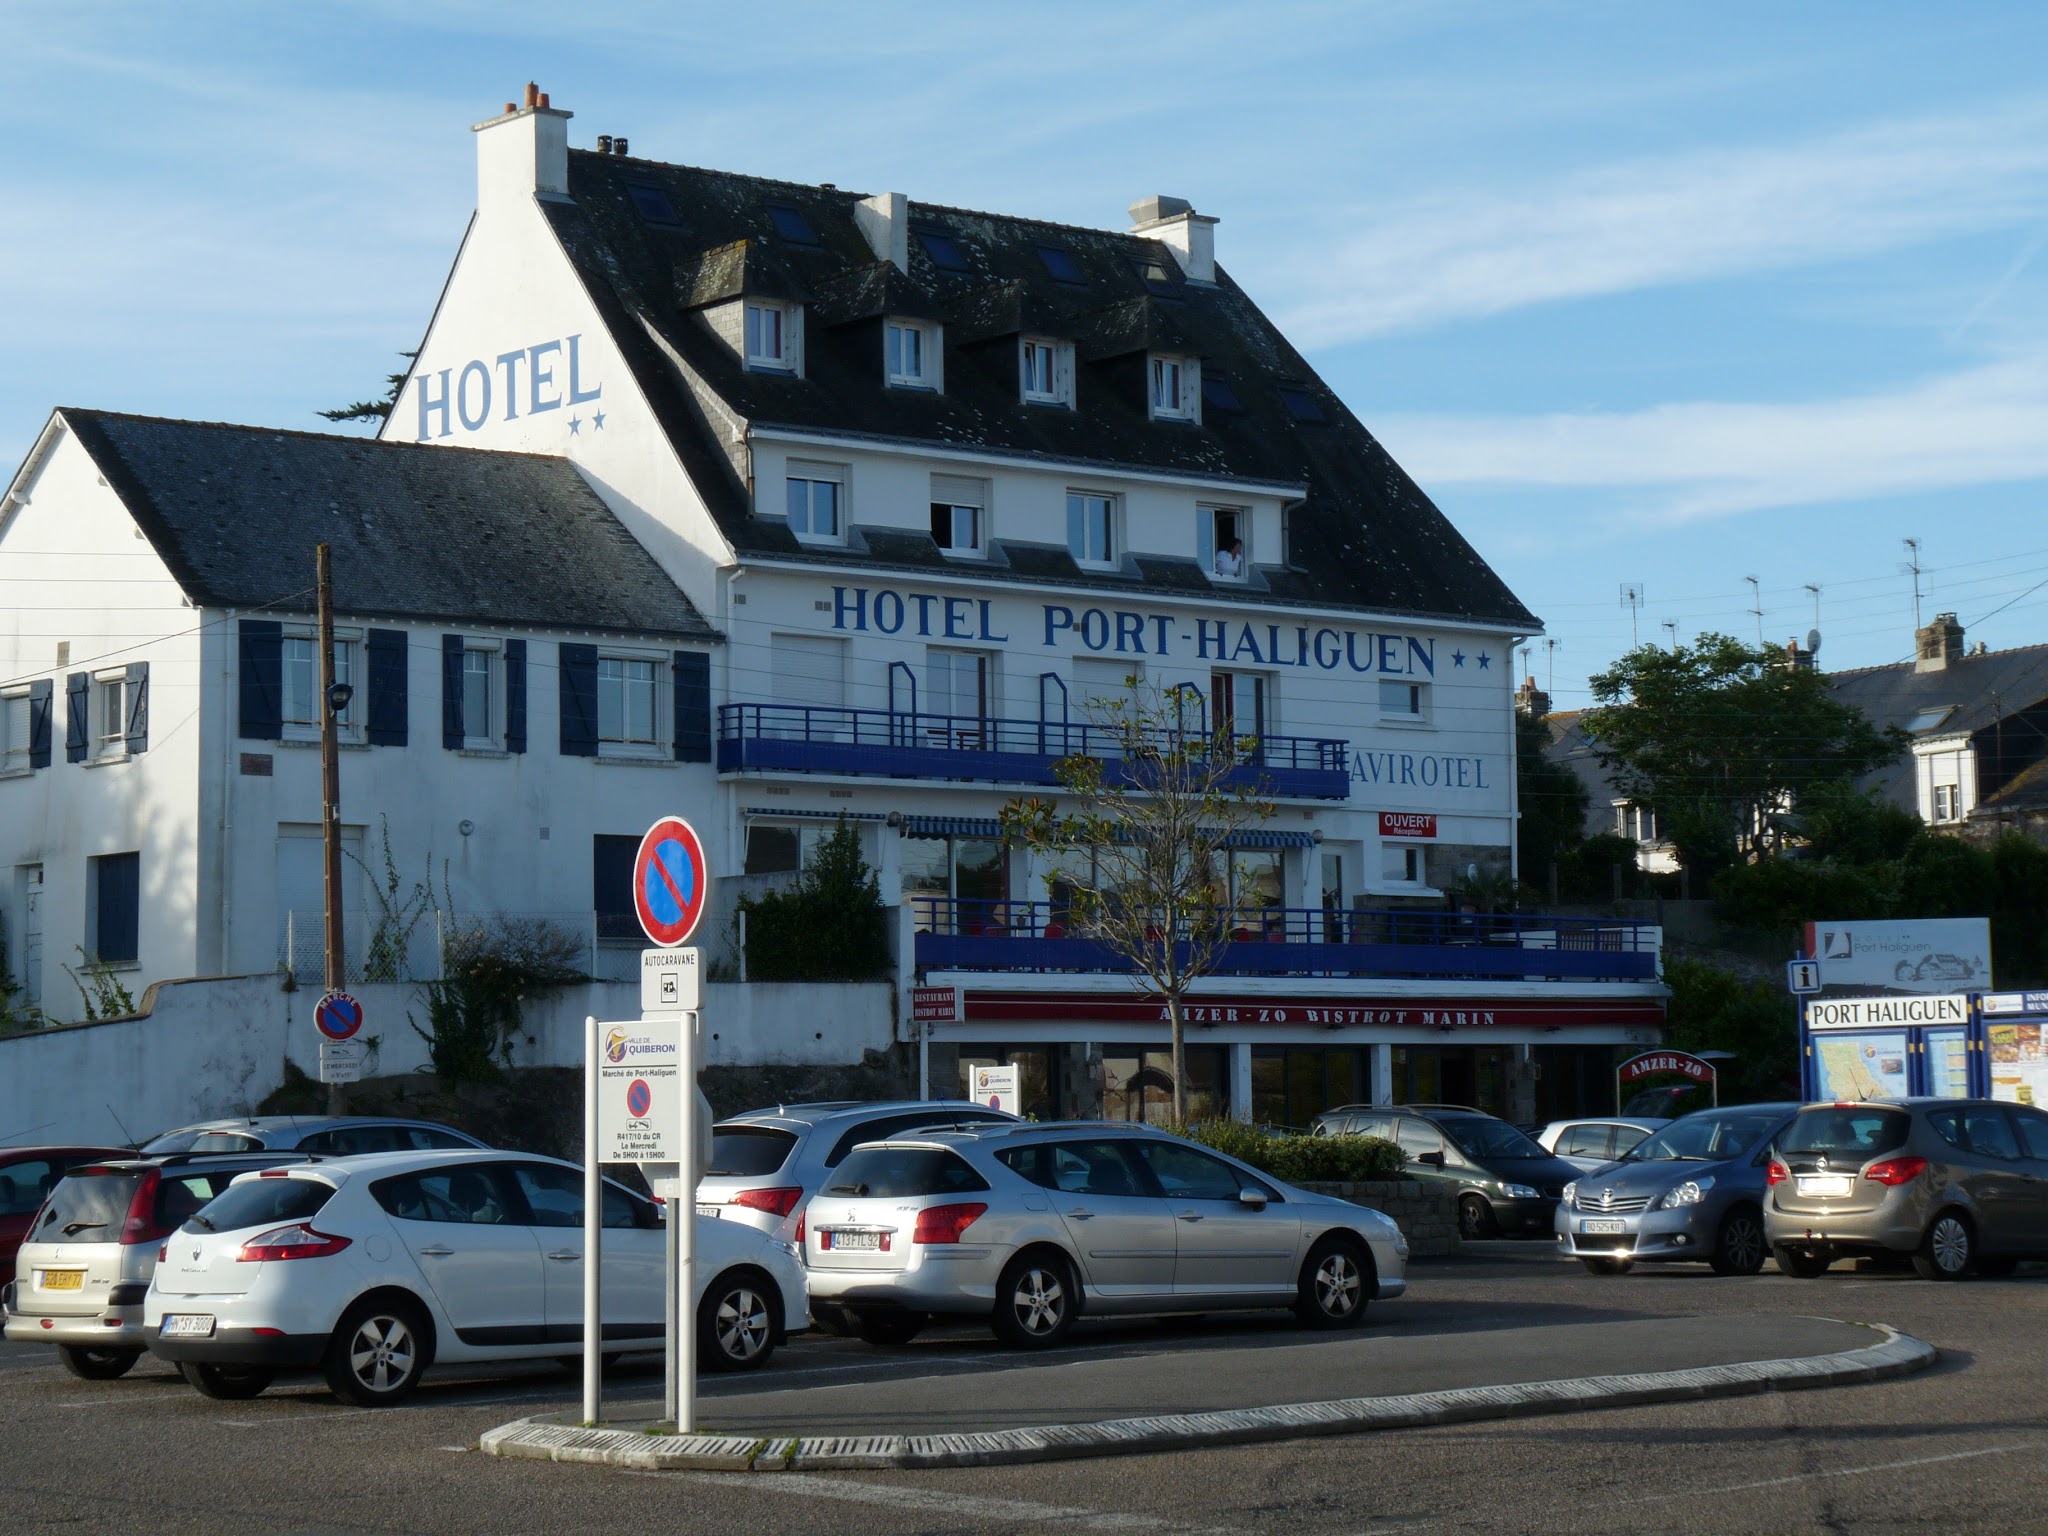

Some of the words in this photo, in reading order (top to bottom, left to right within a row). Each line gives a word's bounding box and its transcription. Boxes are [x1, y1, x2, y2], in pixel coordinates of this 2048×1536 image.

[415, 334, 602, 442] HOTEL
[831, 586, 1008, 642] HOTEL
[1384, 814, 1431, 829] OUVERT
[1393, 827, 1423, 836] Réception
[1855, 942, 1877, 952] Port
[1880, 941, 1931, 954] Haliguen
[644, 952, 695, 966] AUTOCARAVANE
[320, 993, 357, 1010] MARCHE
[914, 992, 954, 1002] RESTAURANT
[1307, 1009, 1406, 1023] BISTROT
[1423, 1012, 1495, 1025] MARIN
[1813, 1003, 1860, 1024] PORT
[1867, 998, 1961, 1022] HALIGUEN
[629, 1044, 676, 1056] QUIBERON
[602, 1069, 624, 1077] Marché
[635, 1068, 677, 1078] Port-Haliguen
[1631, 1057, 1702, 1076] AMZER-ZO
[652, 1132, 661, 1140] CR
[621, 1142, 629, 1150] Le
[613, 1151, 621, 1159] De
[645, 1150, 665, 1159] 15H00
